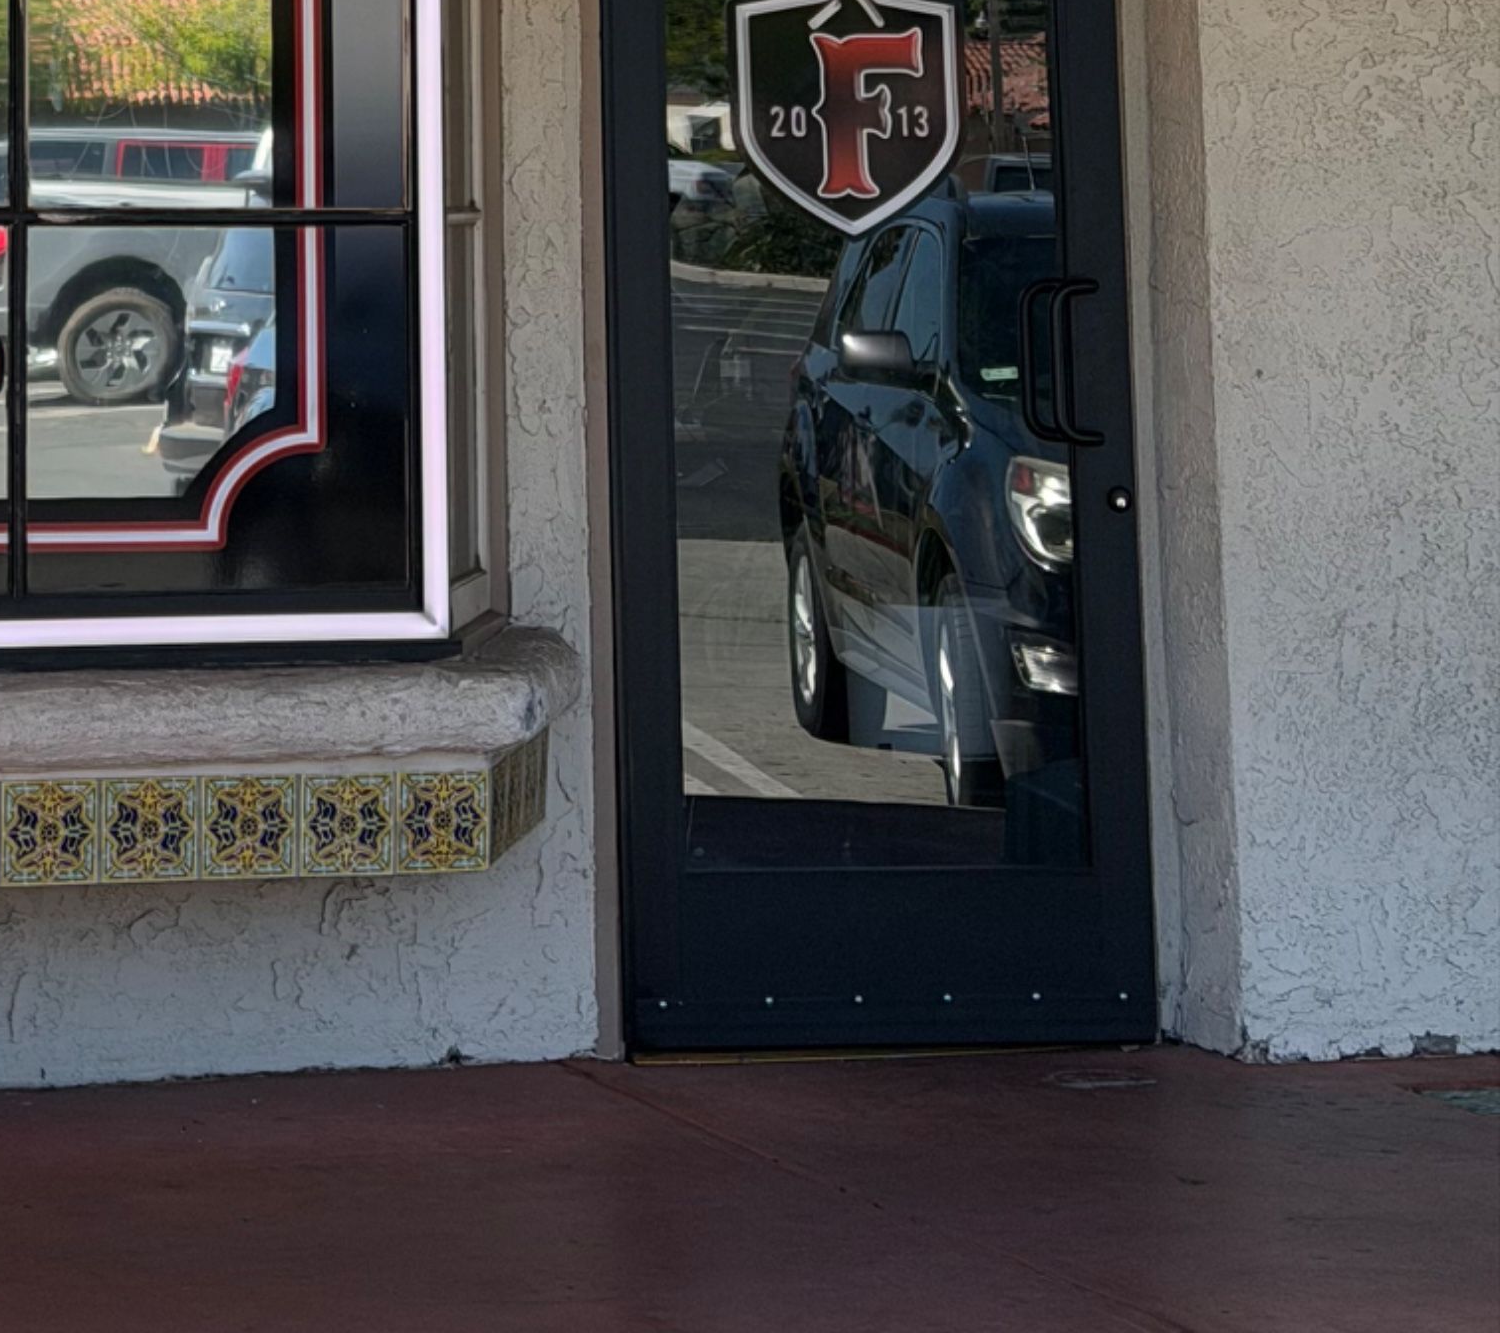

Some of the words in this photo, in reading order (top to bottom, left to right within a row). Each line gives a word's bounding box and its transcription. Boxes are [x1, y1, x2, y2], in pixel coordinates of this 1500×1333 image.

[769, 105, 808, 138] 20
[896, 105, 930, 138] 13
[809, 26, 924, 199] F
